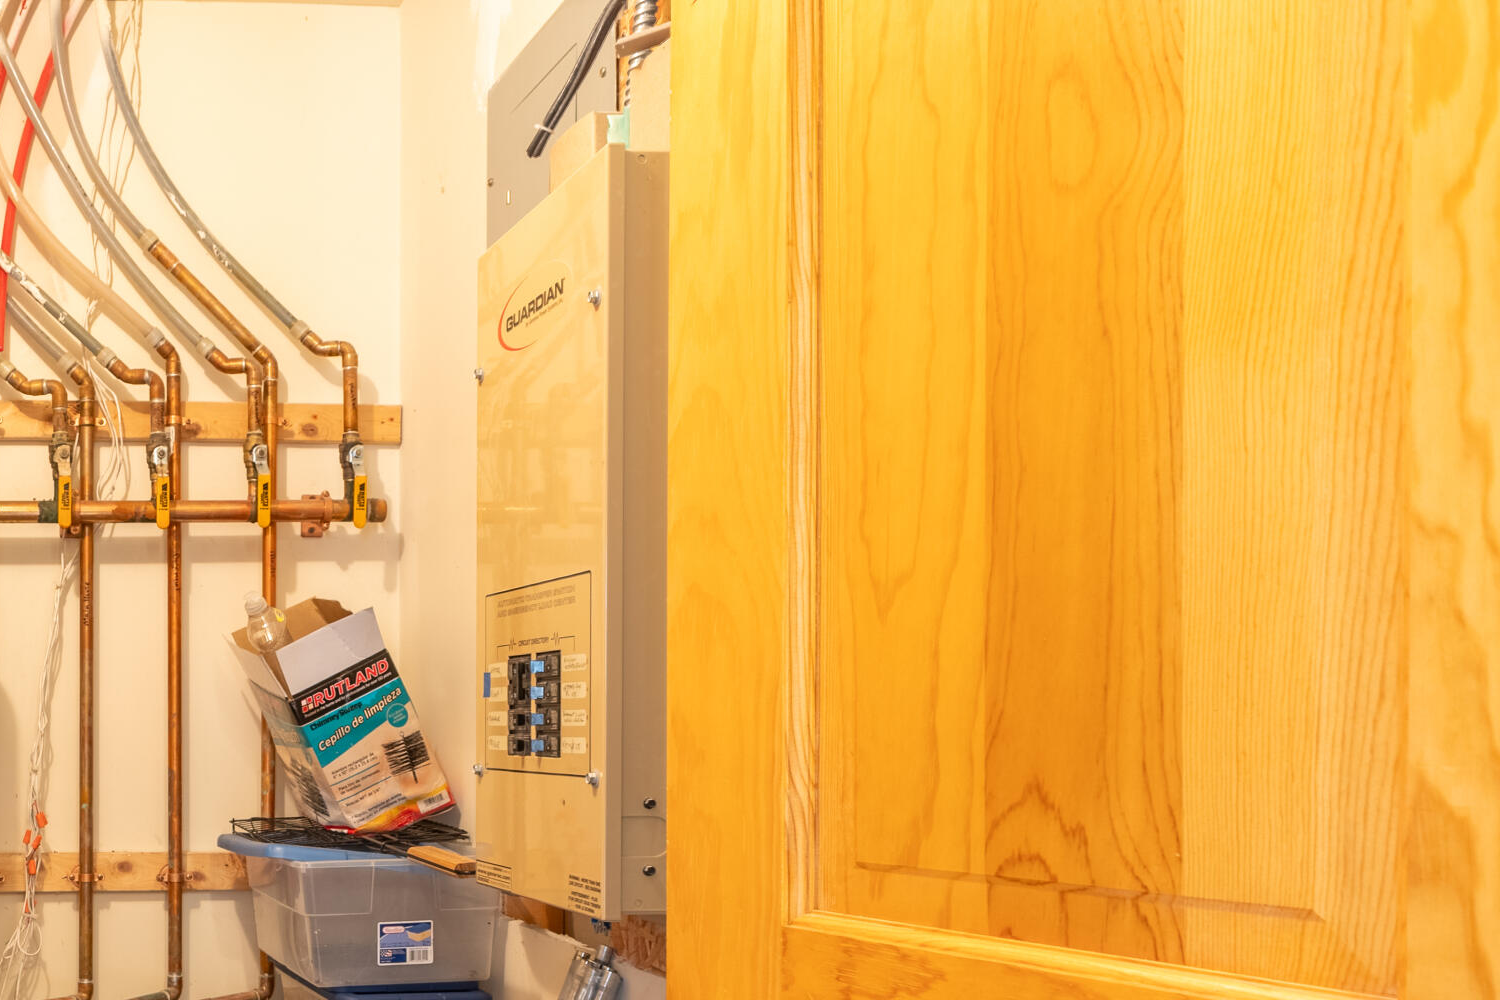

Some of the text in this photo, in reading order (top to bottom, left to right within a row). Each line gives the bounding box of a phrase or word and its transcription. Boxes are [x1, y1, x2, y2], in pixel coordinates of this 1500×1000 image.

[506, 278, 565, 333] GUARDIAN
[312, 659, 389, 707] RUTLAND
[318, 724, 351, 752] Cepillo
[351, 714, 364, 729] de
[363, 687, 402, 720] limpieza
